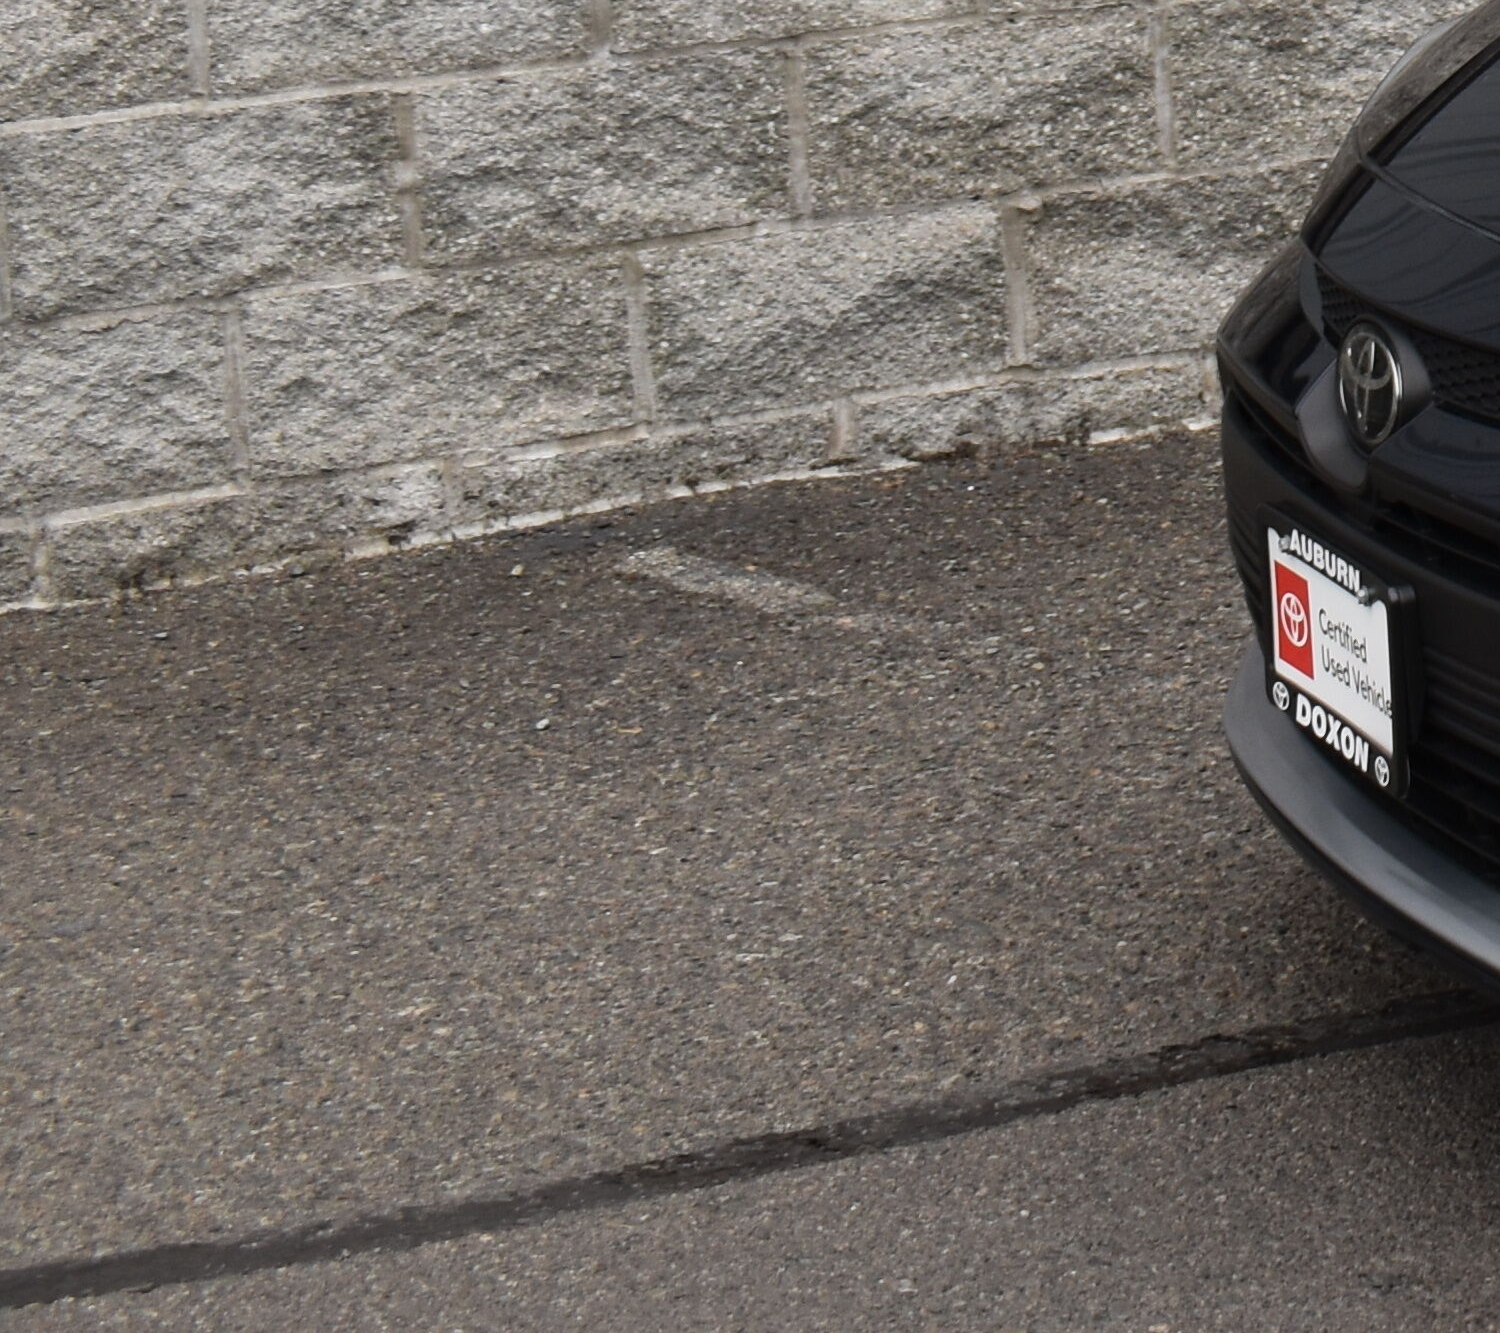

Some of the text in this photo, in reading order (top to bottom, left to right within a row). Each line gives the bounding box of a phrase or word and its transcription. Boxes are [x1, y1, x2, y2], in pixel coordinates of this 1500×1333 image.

[1289, 528, 1361, 593] AUBURN
[1318, 607, 1368, 664] Certified
[1321, 644, 1350, 688] Used
[1295, 692, 1370, 773] DOXON
